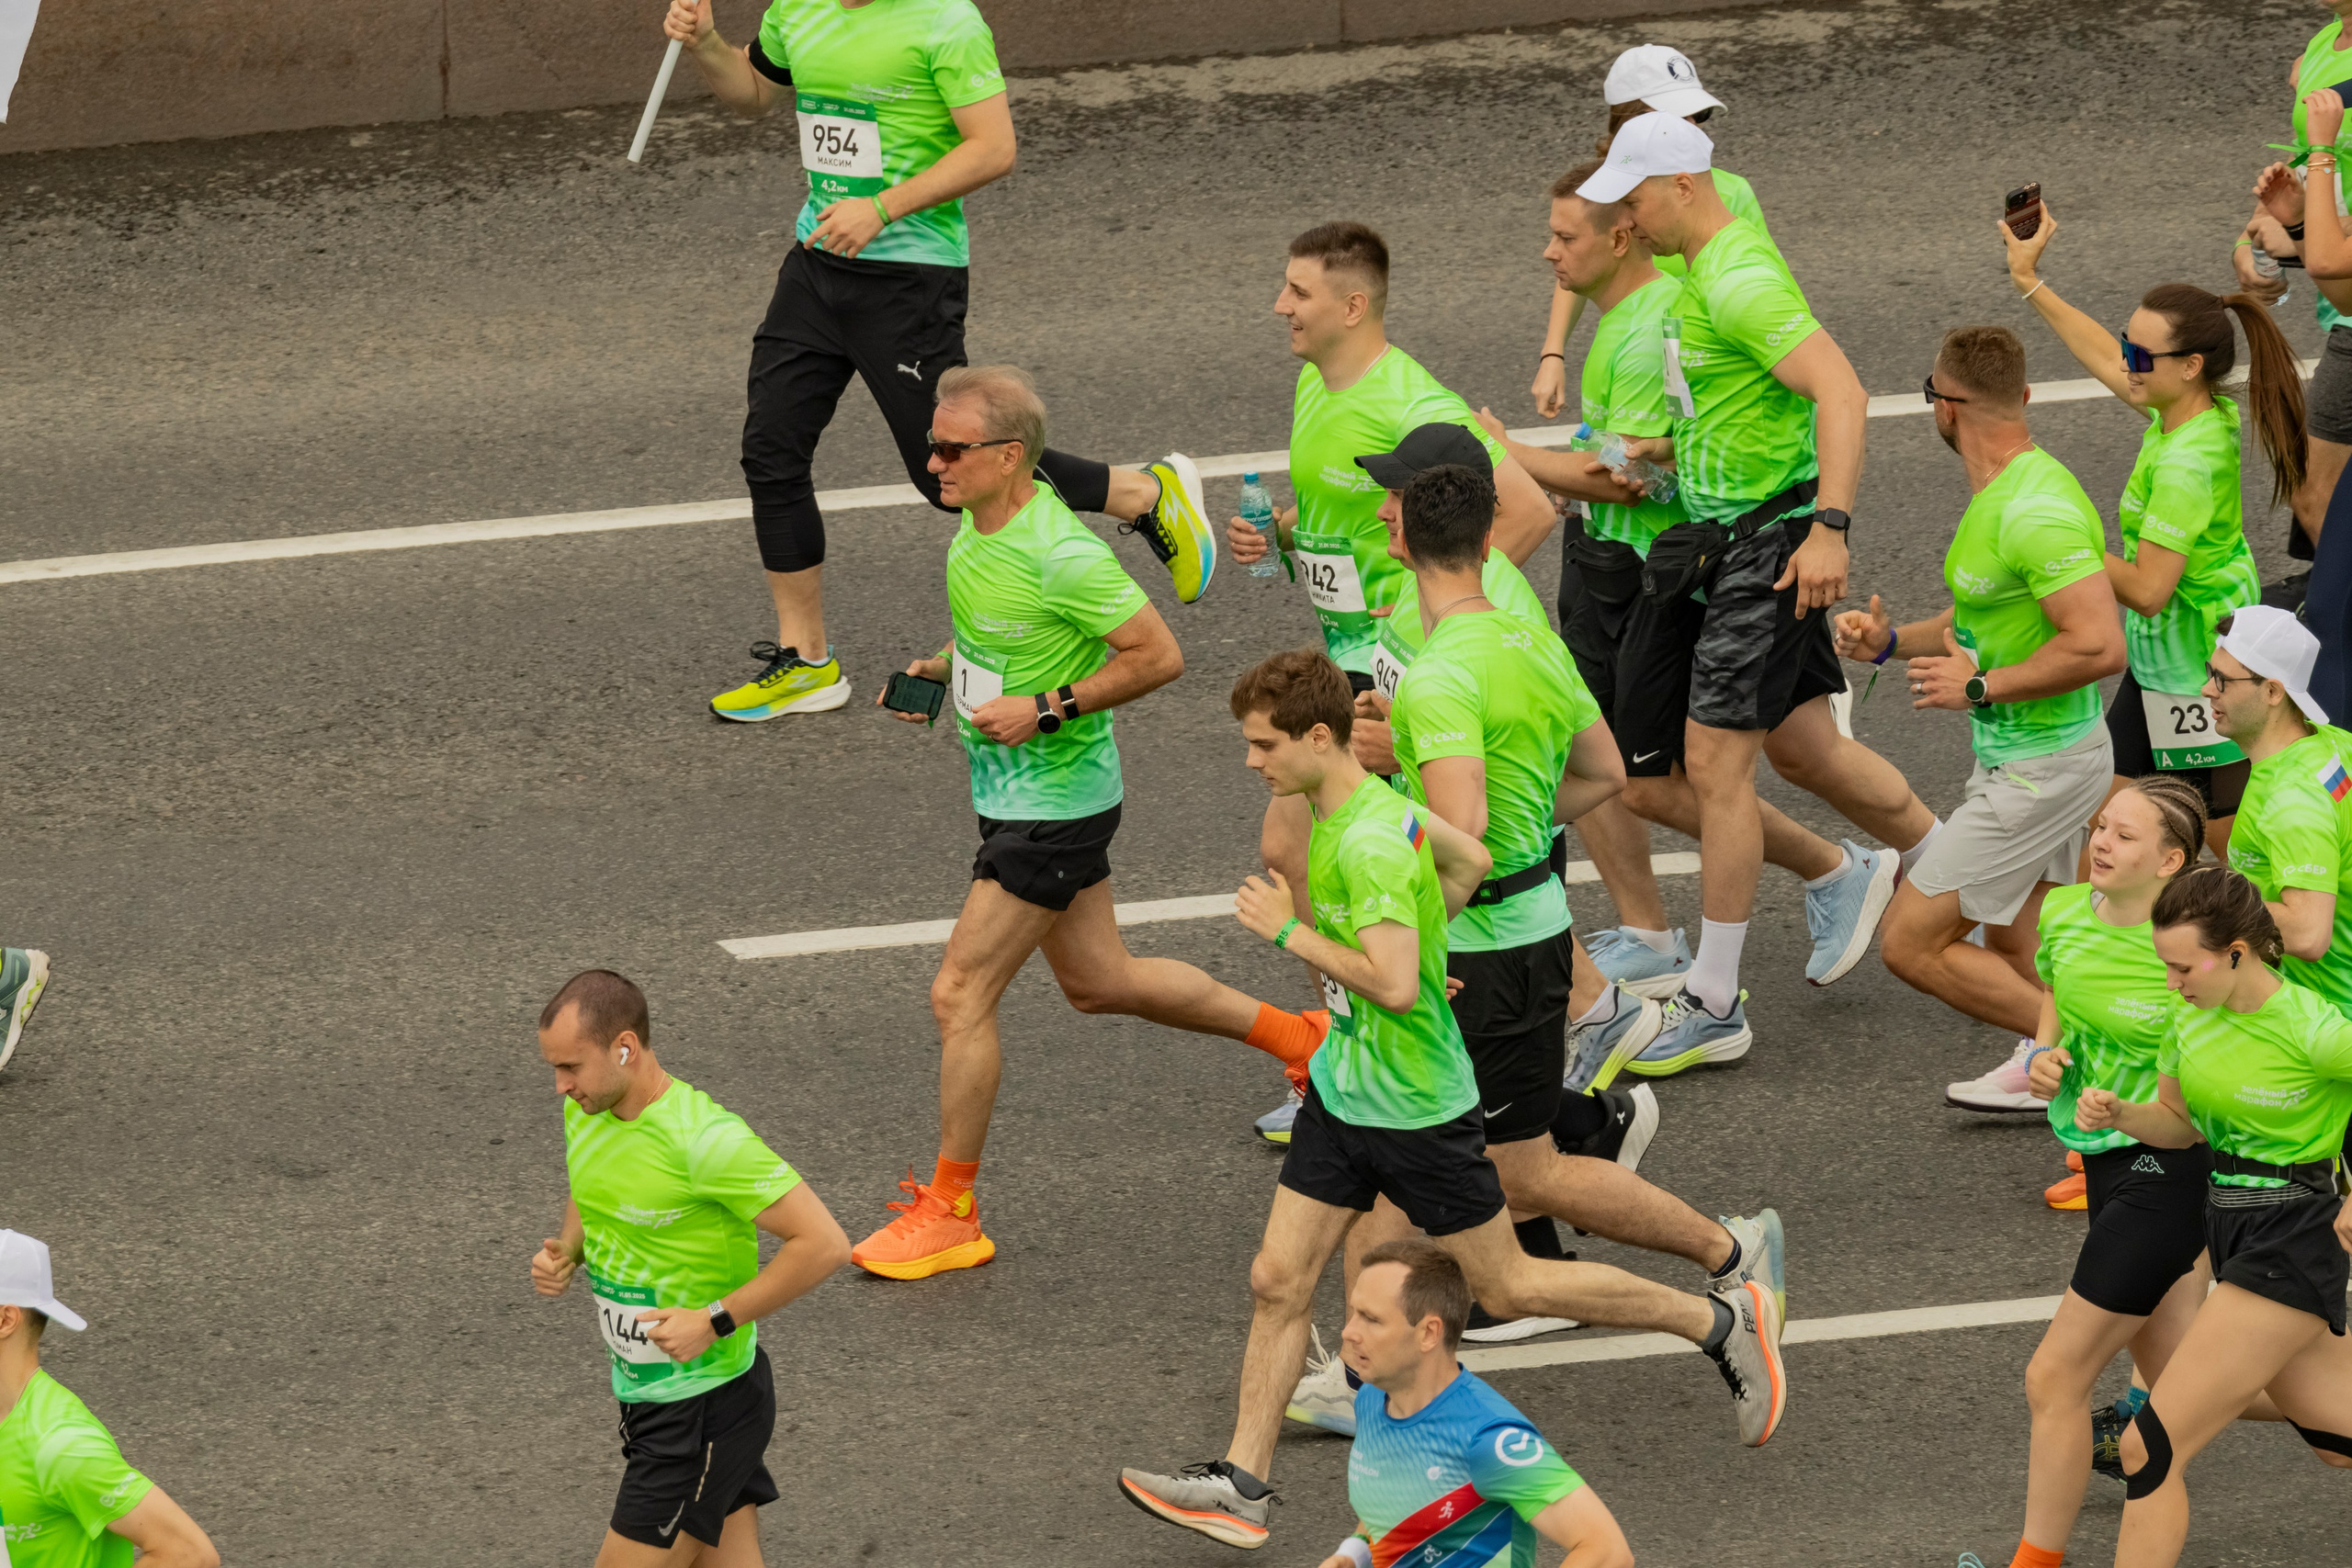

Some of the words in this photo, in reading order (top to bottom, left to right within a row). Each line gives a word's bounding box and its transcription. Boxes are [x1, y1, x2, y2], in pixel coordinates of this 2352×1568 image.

[813, 124, 859, 156] 954
[818, 157, 852, 167] МАКСИМ
[1779, 313, 1804, 334] СБЕР
[1323, 465, 1356, 480] зелёный
[2157, 521, 2186, 538] СБЕР
[2061, 548, 2090, 567] СБЕР
[962, 668, 967, 698] 1
[1376, 658, 1398, 698] 947
[2170, 703, 2209, 735] 23
[1434, 731, 1466, 743] СБЕР
[2115, 997, 2157, 1011] зелёный
[2108, 1006, 2151, 1020] марафон
[2233, 1092, 2281, 1108] марафон
[2241, 1085, 2287, 1099] зелёный
[618, 1291, 646, 1300] 31.05.2025
